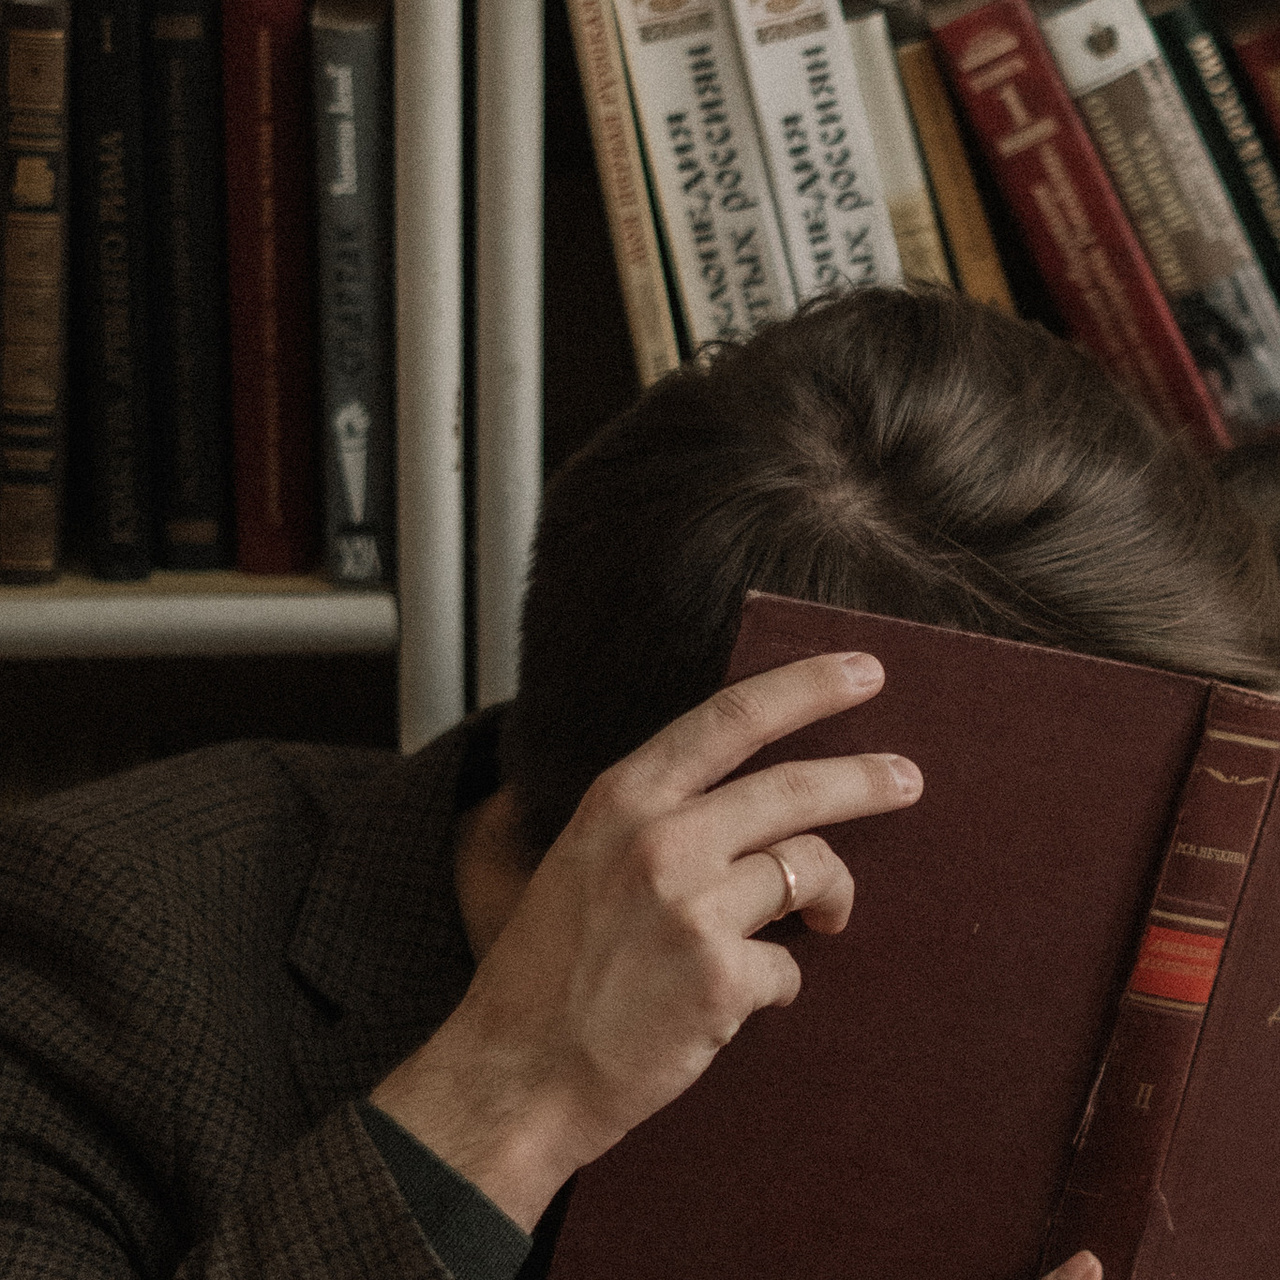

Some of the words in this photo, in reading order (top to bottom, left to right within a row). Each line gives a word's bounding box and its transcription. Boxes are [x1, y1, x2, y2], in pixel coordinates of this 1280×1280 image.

[1187, 31, 1258, 146] РОССИИ
[98, 130, 128, 224] РИМА
[1133, 1082, 1157, 1110] II
